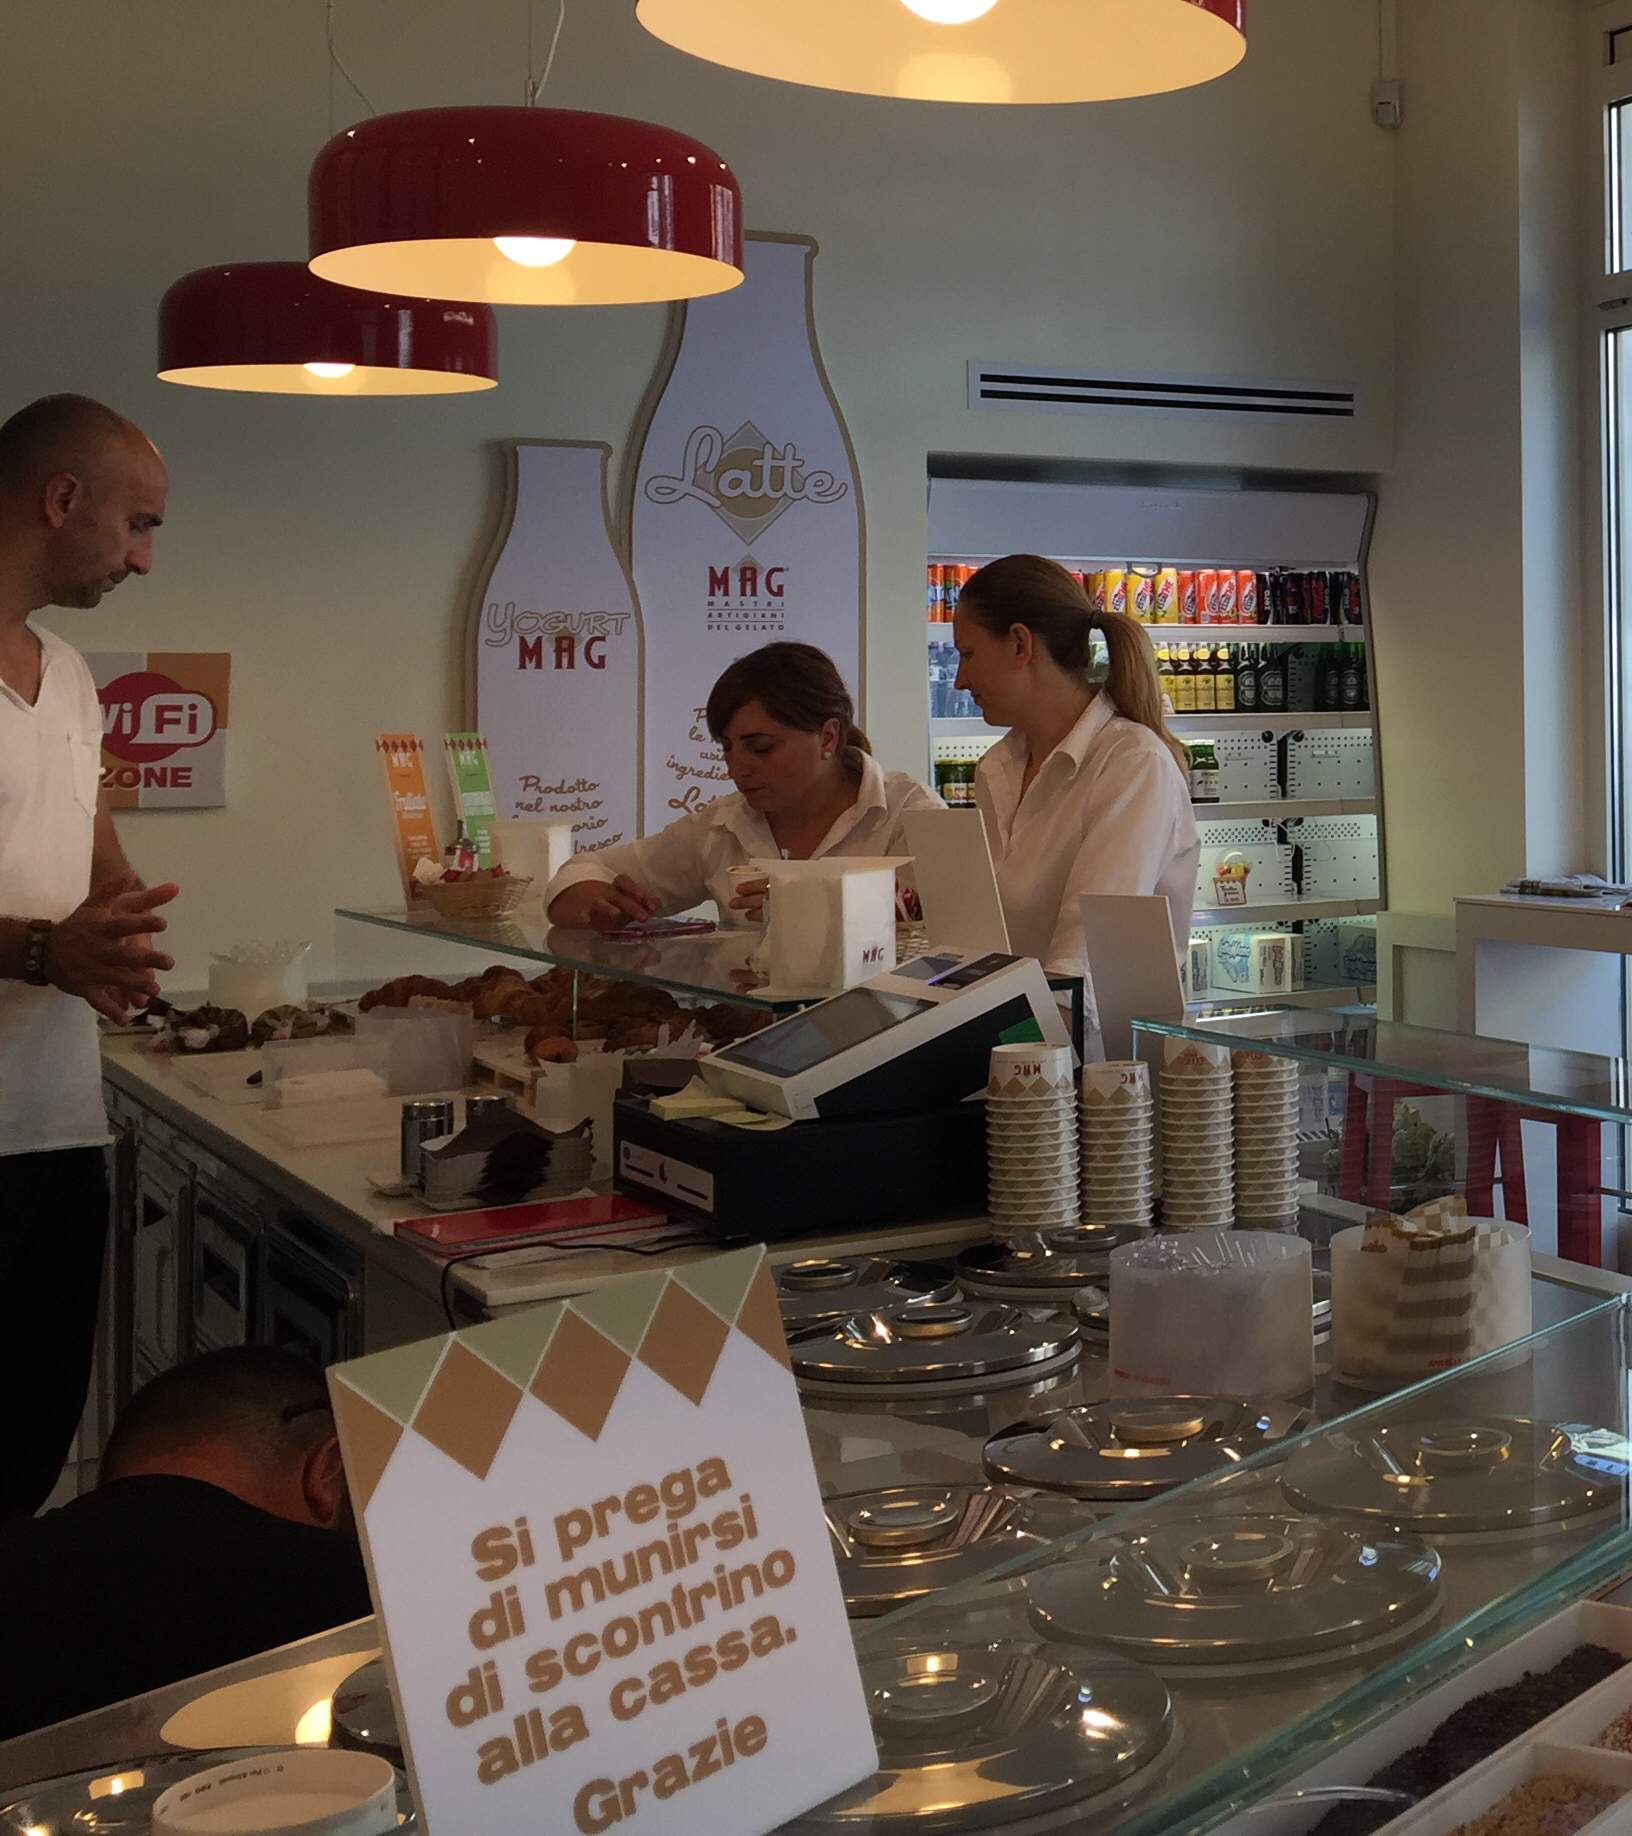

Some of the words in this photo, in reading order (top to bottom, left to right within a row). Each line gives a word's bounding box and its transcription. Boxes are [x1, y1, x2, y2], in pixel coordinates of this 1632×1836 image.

[644, 424, 848, 509] Latte
[707, 566, 785, 597] MAG
[517, 635, 608, 670] MAG
[100, 767, 193, 789] ZONE
[519, 775, 601, 795] Prodotto
[515, 797, 544, 813] nel
[549, 797, 605, 813] nostro
[862, 947, 885, 964] MAG
[1013, 1063, 1041, 1078] MAG
[470, 1515, 536, 1582] Si
[554, 1457, 733, 1563] prega
[468, 1585, 527, 1651] di
[544, 1492, 759, 1622] munirsi
[445, 1660, 505, 1729] di
[524, 1548, 796, 1694] scontrino
[477, 1704, 590, 1786] alla
[609, 1614, 797, 1722] cassa.
[573, 1714, 769, 1836] Grazie
